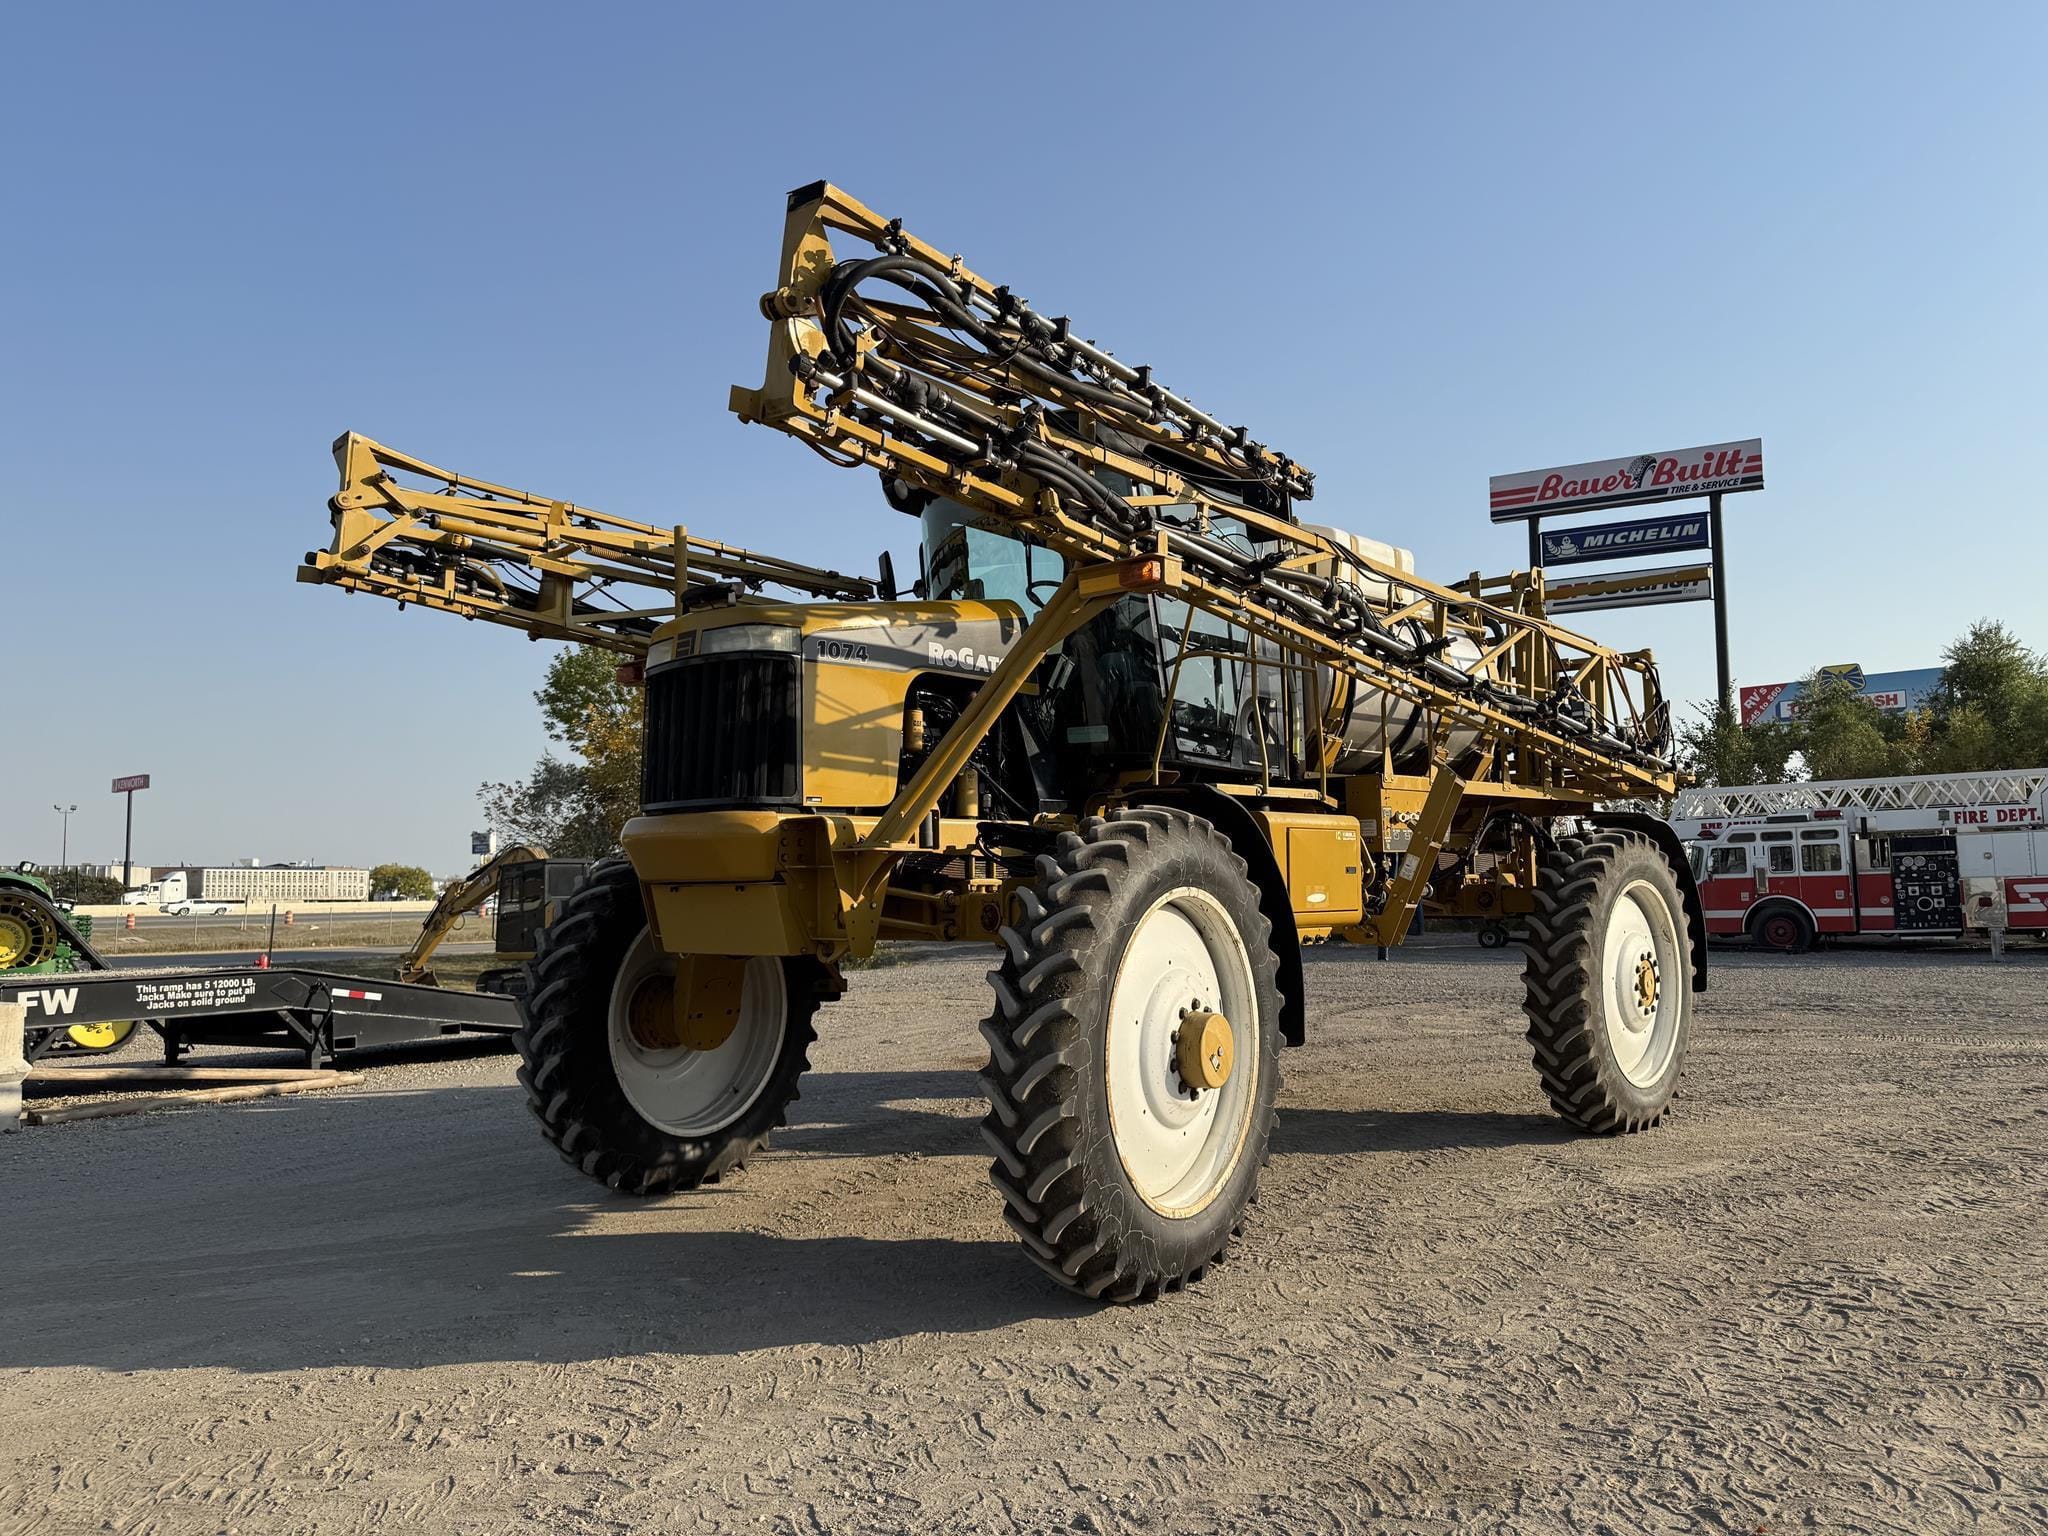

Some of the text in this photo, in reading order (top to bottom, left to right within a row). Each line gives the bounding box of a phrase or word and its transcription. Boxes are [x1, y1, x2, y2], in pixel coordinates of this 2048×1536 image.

[1537, 449, 1743, 501] Bauer Built
[1670, 477, 1740, 495] TIRE & SERVICE
[1583, 522, 1702, 548] MICHELIN
[816, 640, 869, 662] 1074
[1759, 702, 1769, 710] to
[1953, 807, 2042, 825] FIRE DEPT.
[136, 984, 157, 993] This
[160, 984, 183, 993] ramp
[186, 981, 202, 990] has
[204, 980, 211, 989] 5
[213, 979, 239, 988] 12000
[136, 986, 256, 1002] Jacks Make sure to put all
[17, 987, 79, 1017] FW
[146, 995, 246, 1010] Jacks on solid ground
